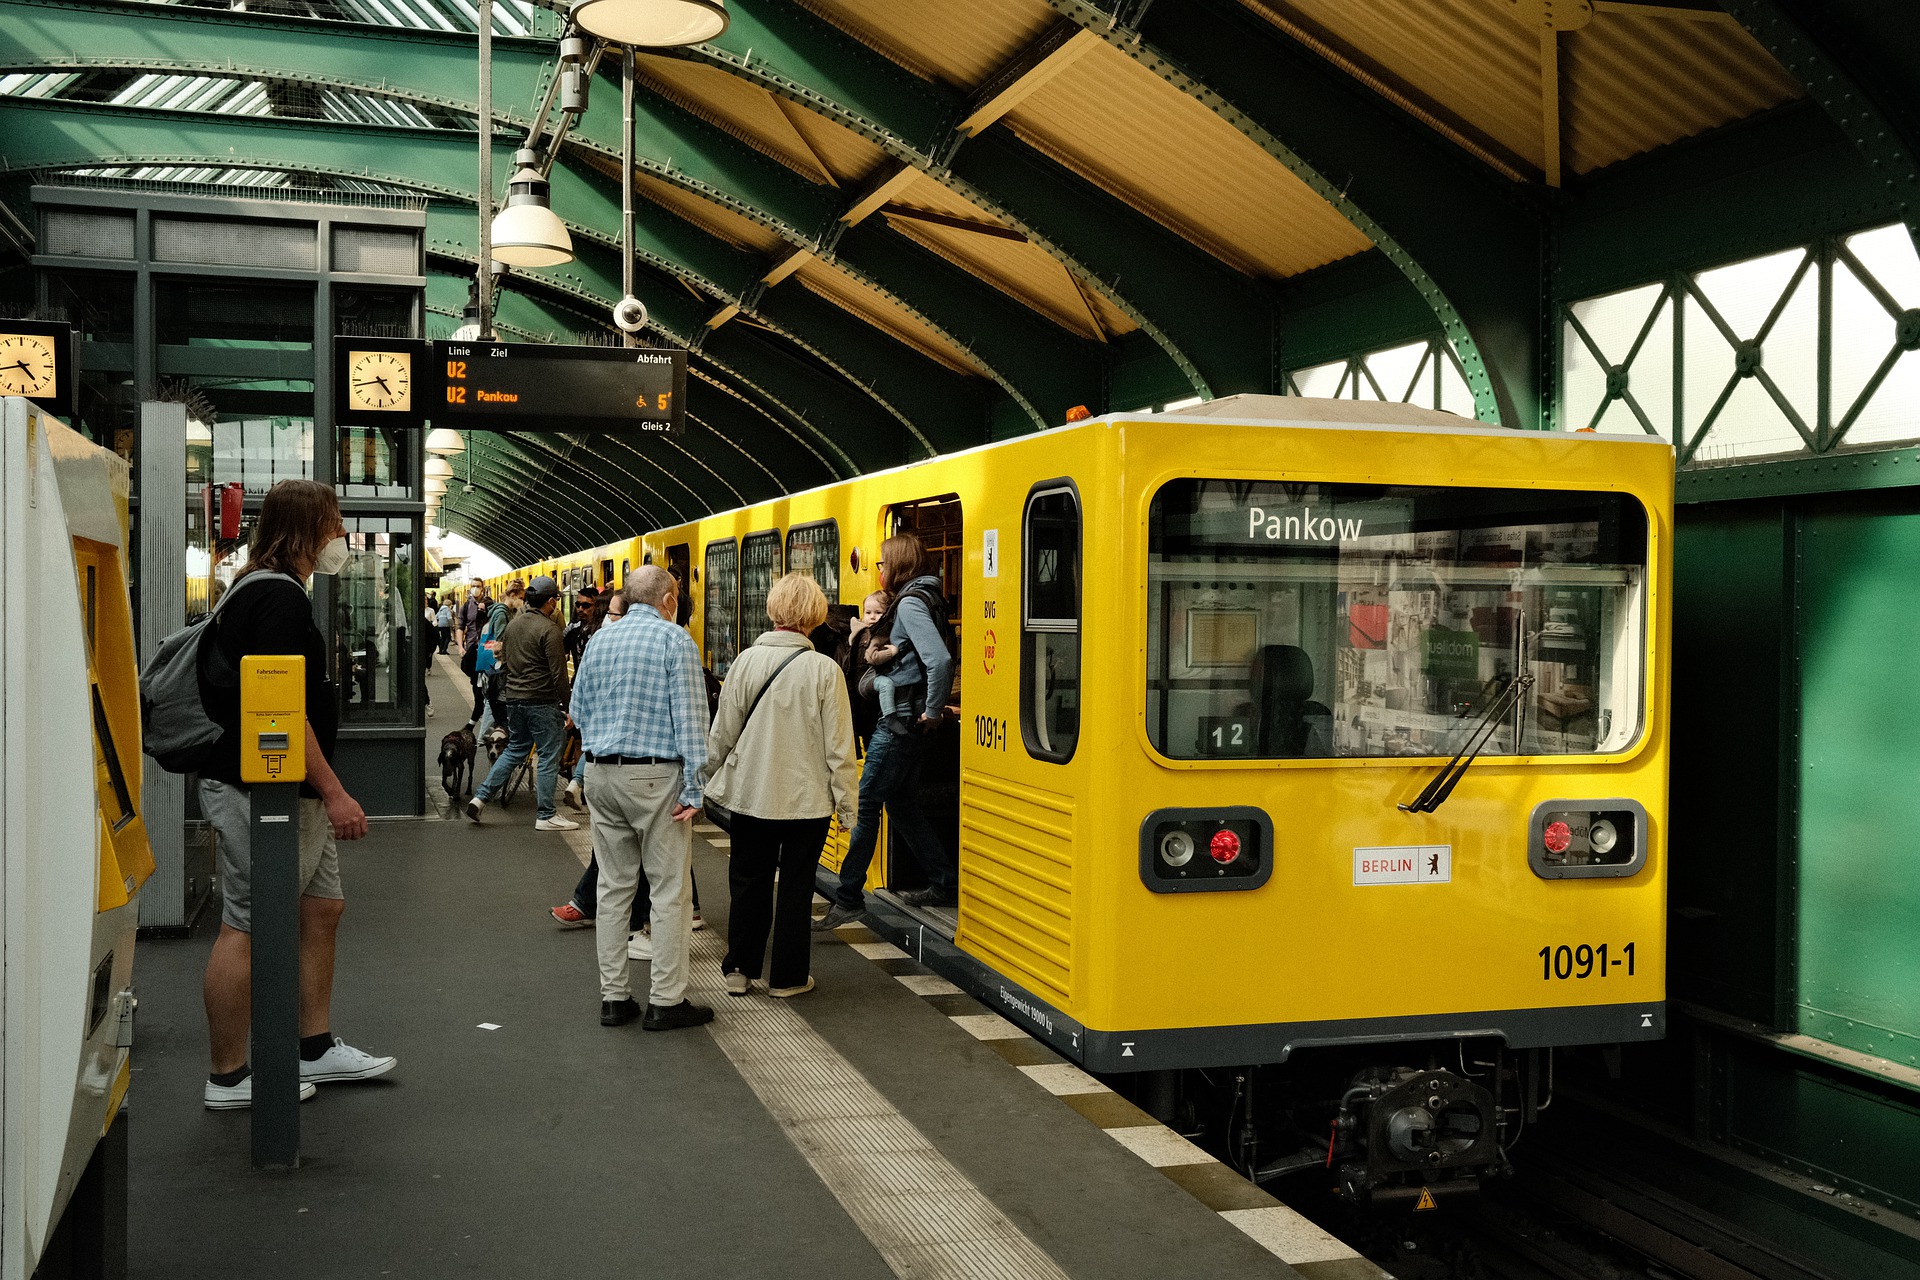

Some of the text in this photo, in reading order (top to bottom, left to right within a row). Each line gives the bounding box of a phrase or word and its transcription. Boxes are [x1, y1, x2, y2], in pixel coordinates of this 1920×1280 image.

[448, 346, 471, 356] Linie
[490, 348, 508, 358] Ziel
[636, 354, 672, 364] Abfahrt
[447, 361, 467, 379] U2
[446, 386, 466, 404] U2
[477, 390, 518, 402] Pankow
[641, 421, 671, 431] Gleis 2
[1249, 507, 1362, 541] Pankow
[984, 600, 996, 619] BVG
[984, 645, 995, 659] VBB
[975, 714, 1006, 752] 1091-1
[1361, 858, 1412, 873] BERLIN
[1538, 942, 1635, 980] 1091-1
[1000, 985, 1053, 1035] Eigengewicht 19000 kg
